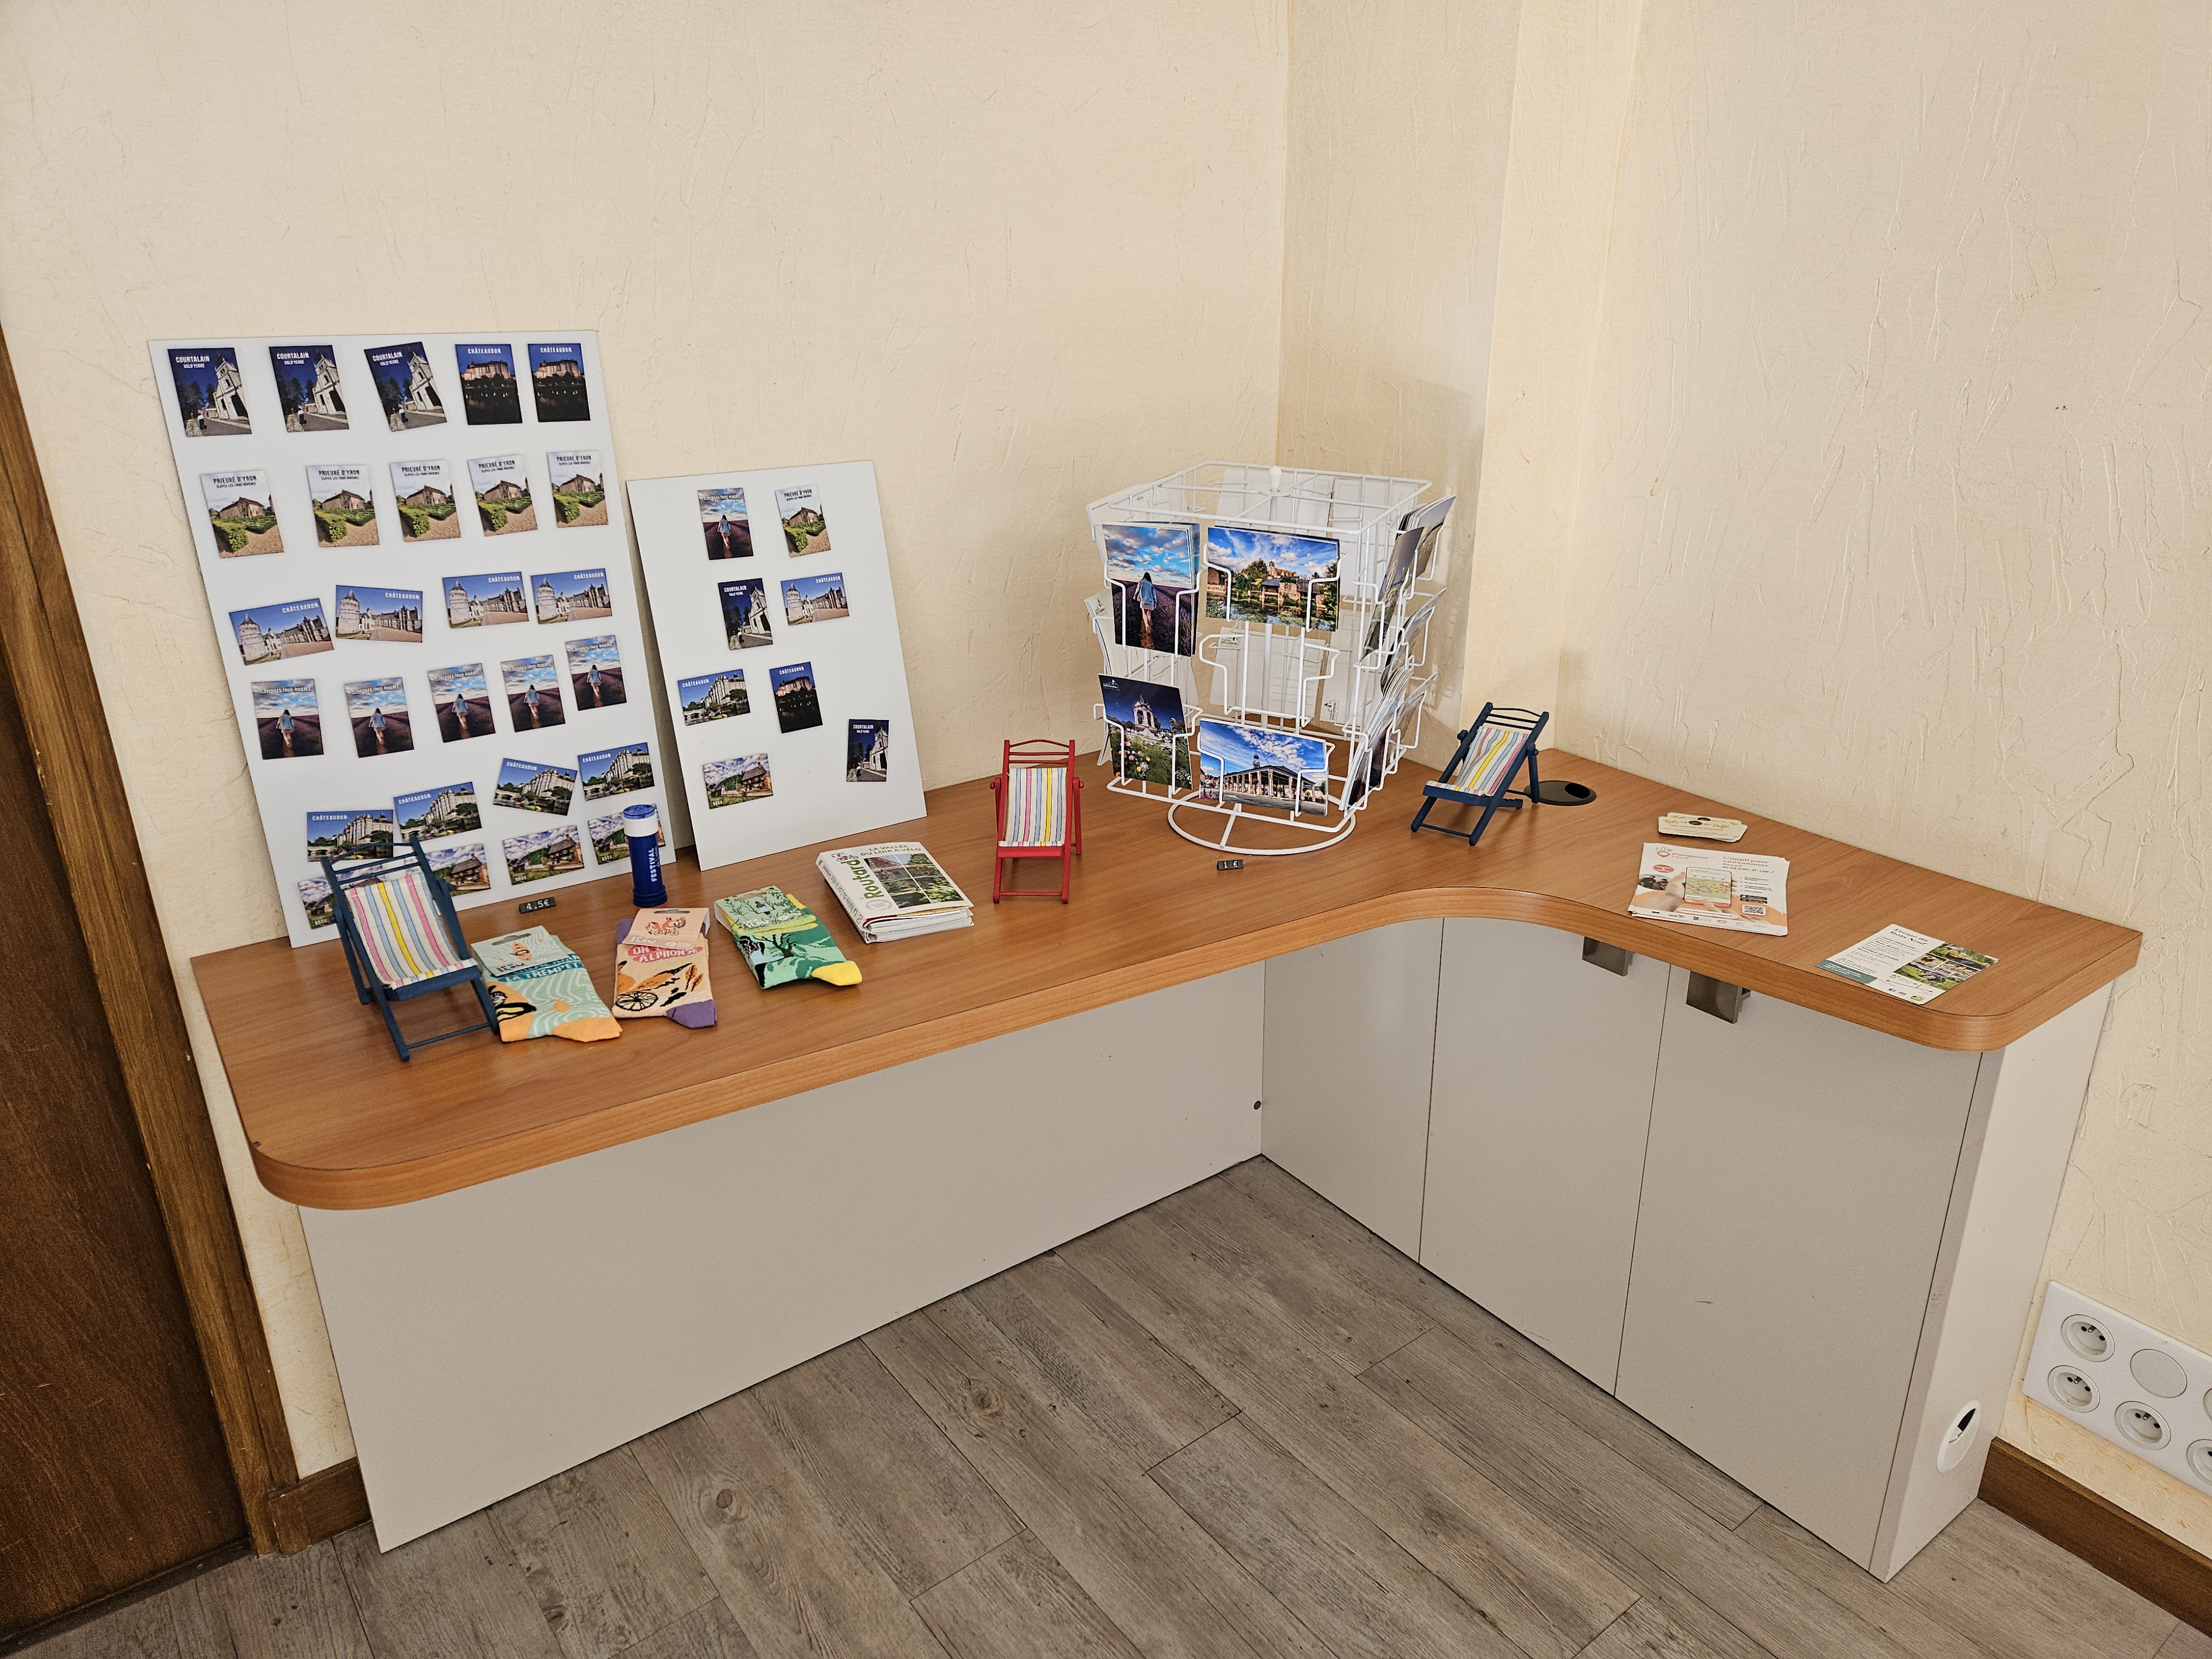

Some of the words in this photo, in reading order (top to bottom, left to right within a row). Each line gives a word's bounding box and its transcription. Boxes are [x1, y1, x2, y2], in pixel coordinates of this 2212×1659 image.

[372, 351, 403, 361] COURTALAIN
[282, 603, 319, 613] CHÂTEAUDUN
[779, 666, 805, 675] CHÂTEAUDUN
[682, 679, 709, 687] CHÂTEAUDUN
[582, 753, 611, 763] CHÂTEAUDUN
[506, 761, 538, 771] CHÂTEAUDUN
[398, 794, 430, 804] CHÂTEAUDUN
[648, 847, 658, 882] FESTIVAL
[841, 859, 885, 899] Routard
[526, 899, 550, 910] 4.5€
[633, 945, 650, 955] ON
[639, 948, 697, 962] ALPHONSE
